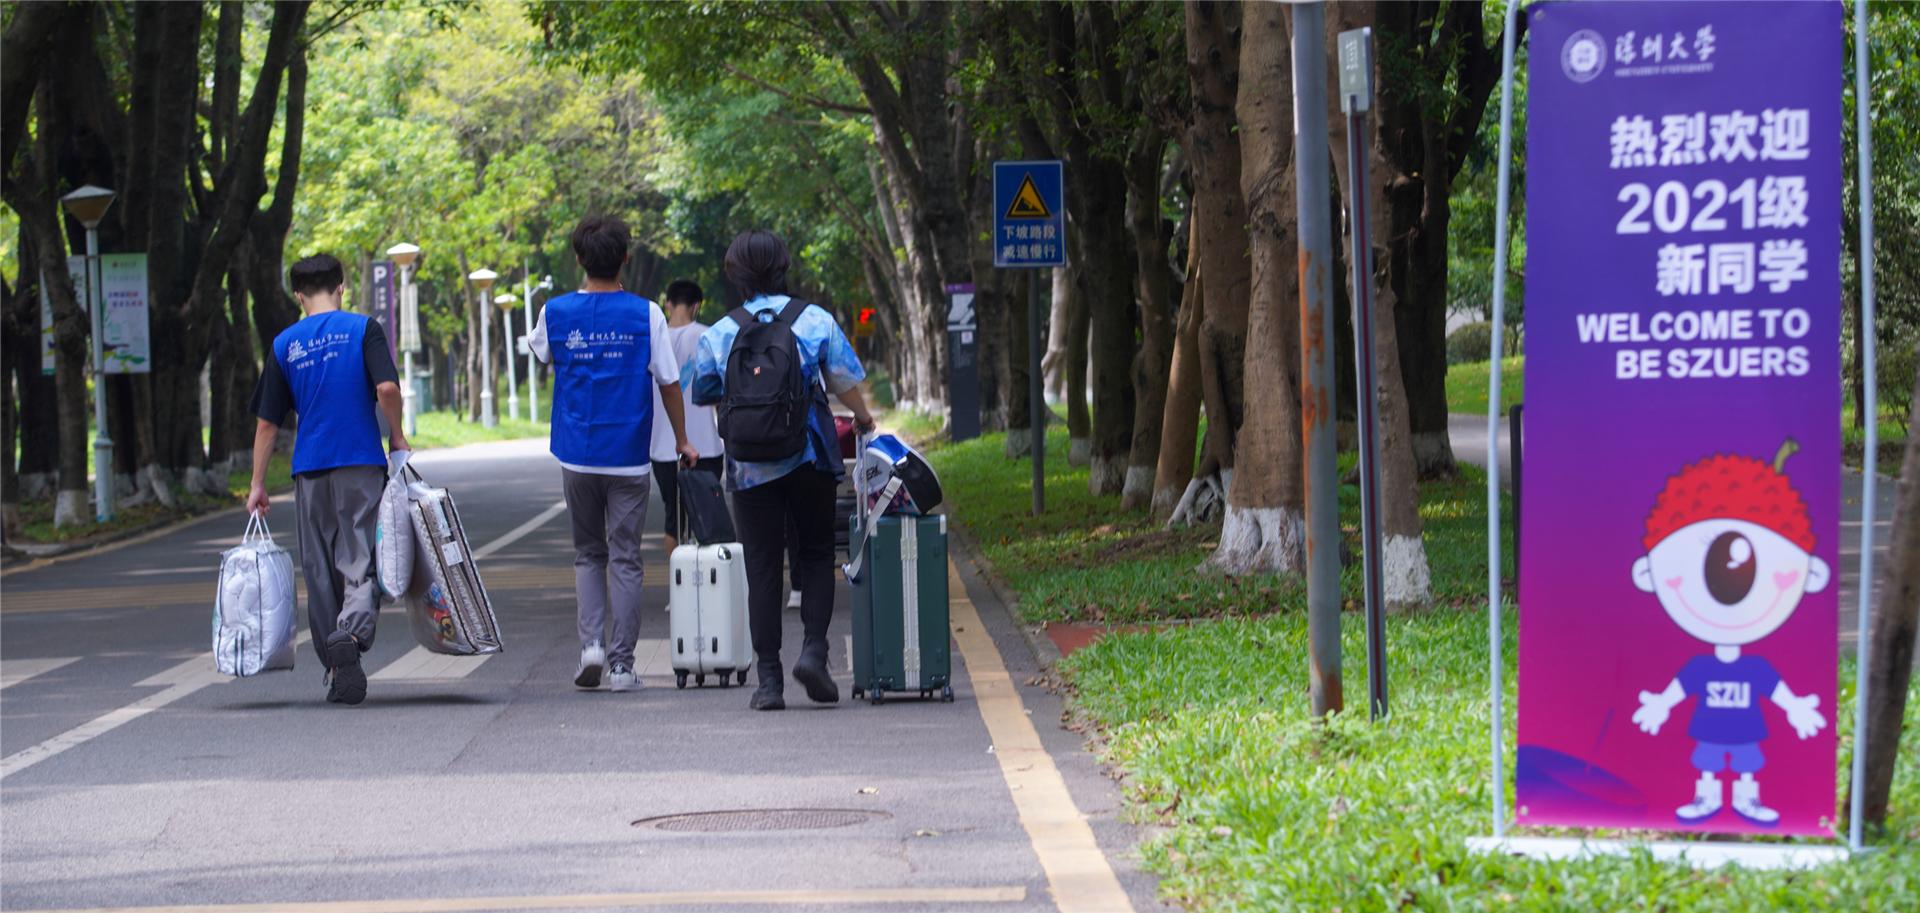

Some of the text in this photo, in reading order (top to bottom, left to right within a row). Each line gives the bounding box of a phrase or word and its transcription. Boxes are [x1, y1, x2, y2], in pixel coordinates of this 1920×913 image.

[1609, 108, 1810, 169] 热烈欢迎
[1616, 176, 1809, 234] 2021级
[1003, 225, 1056, 240] 下坡路段
[1003, 244, 1056, 259] 减速慢行
[1656, 239, 1808, 296] 新同学
[374, 266, 387, 283] P
[1576, 308, 1811, 343] WELCOME TO
[1616, 346, 1810, 379] BE SZUERS
[1706, 681, 1751, 708] SZU
